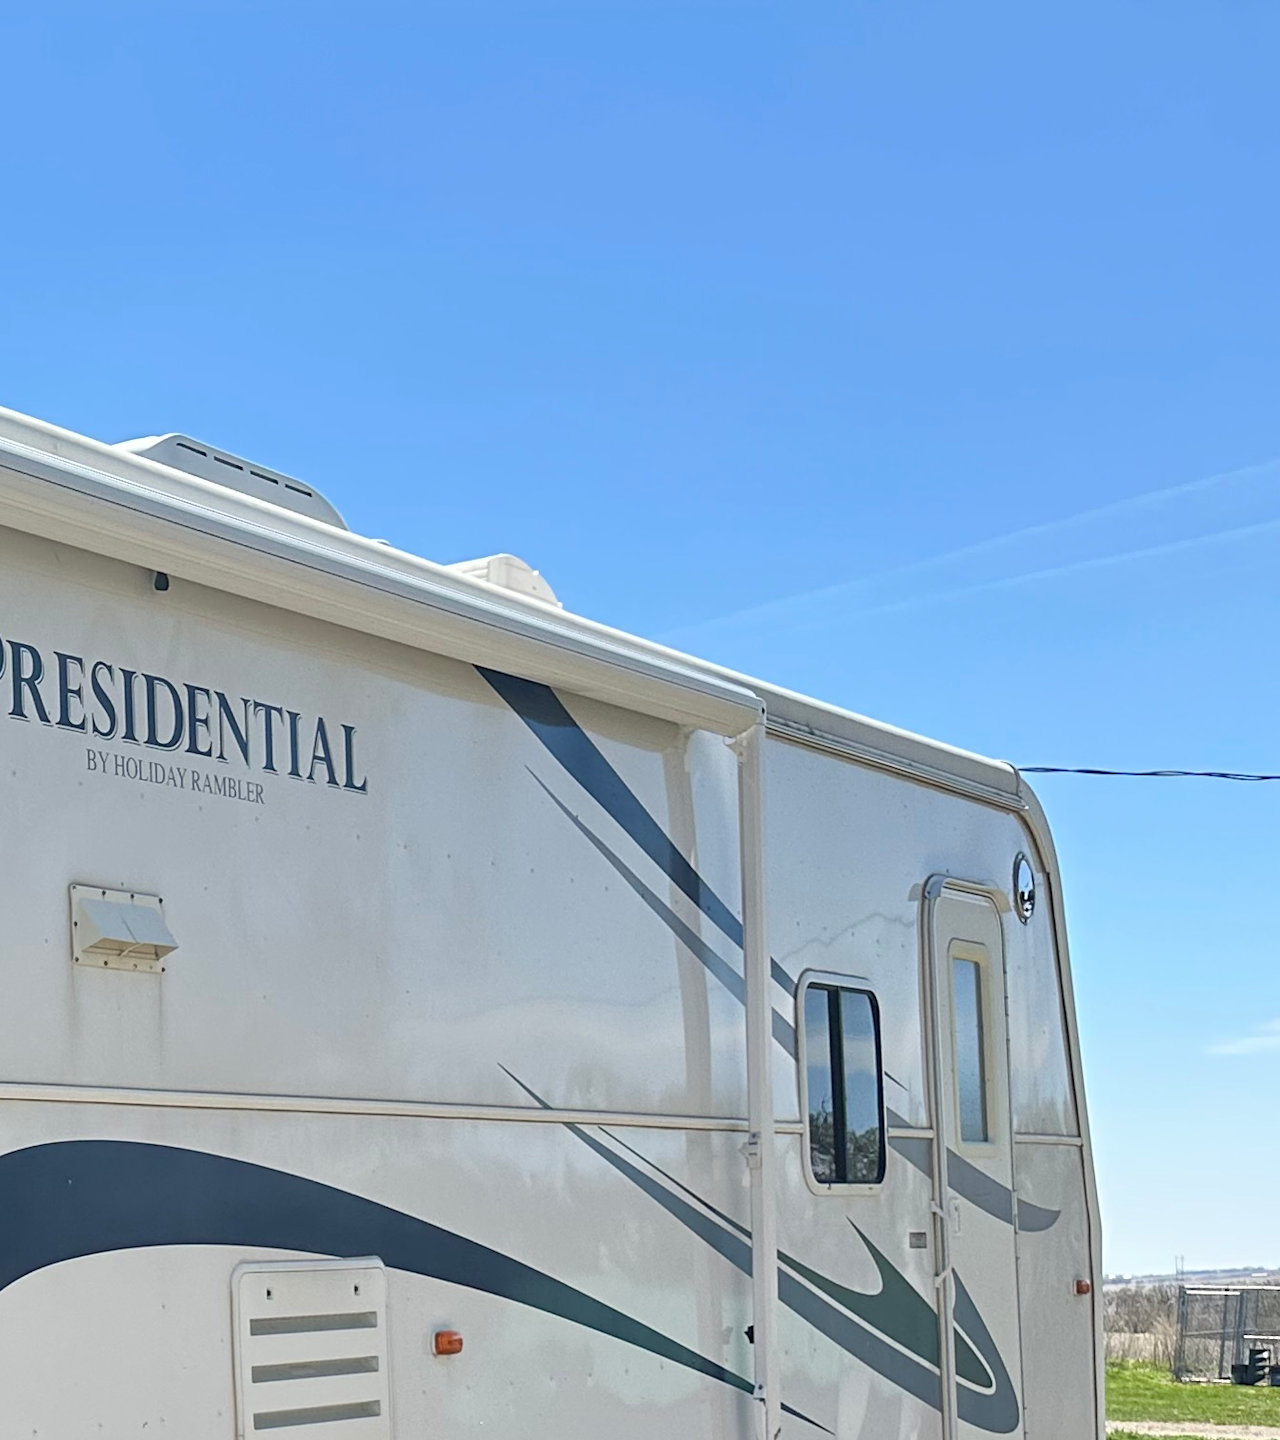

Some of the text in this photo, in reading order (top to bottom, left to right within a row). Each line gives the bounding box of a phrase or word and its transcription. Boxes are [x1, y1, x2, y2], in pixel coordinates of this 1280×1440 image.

[86, 748, 265, 804] BY HOLIDAY RAMBLER
